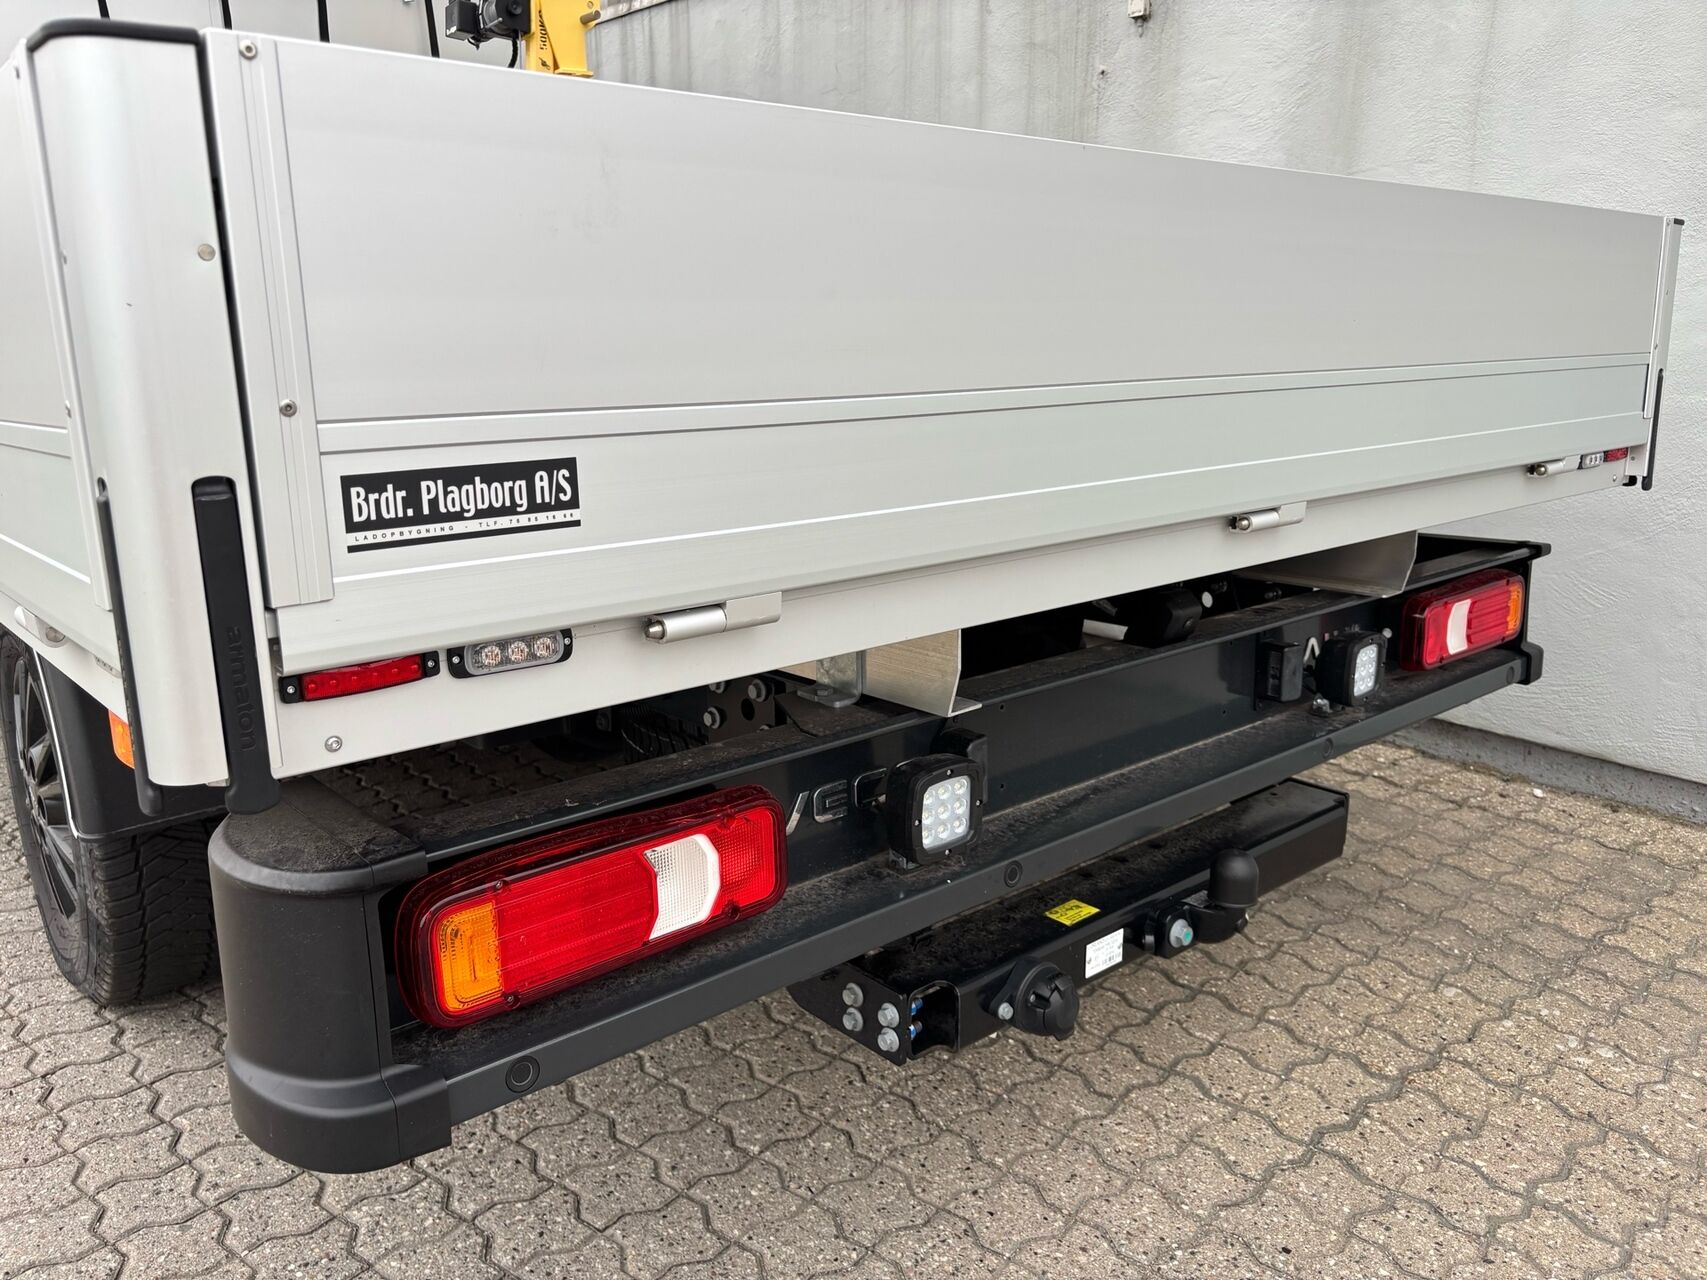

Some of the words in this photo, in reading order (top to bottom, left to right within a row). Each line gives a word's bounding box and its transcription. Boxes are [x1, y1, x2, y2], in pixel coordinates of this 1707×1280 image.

[350, 483, 414, 523] Brdr.
[420, 476, 528, 518] Plagborg
[534, 468, 572, 506] A/S
[354, 524, 455, 542] LADOPBYGNING
[226, 626, 257, 751] armaton
